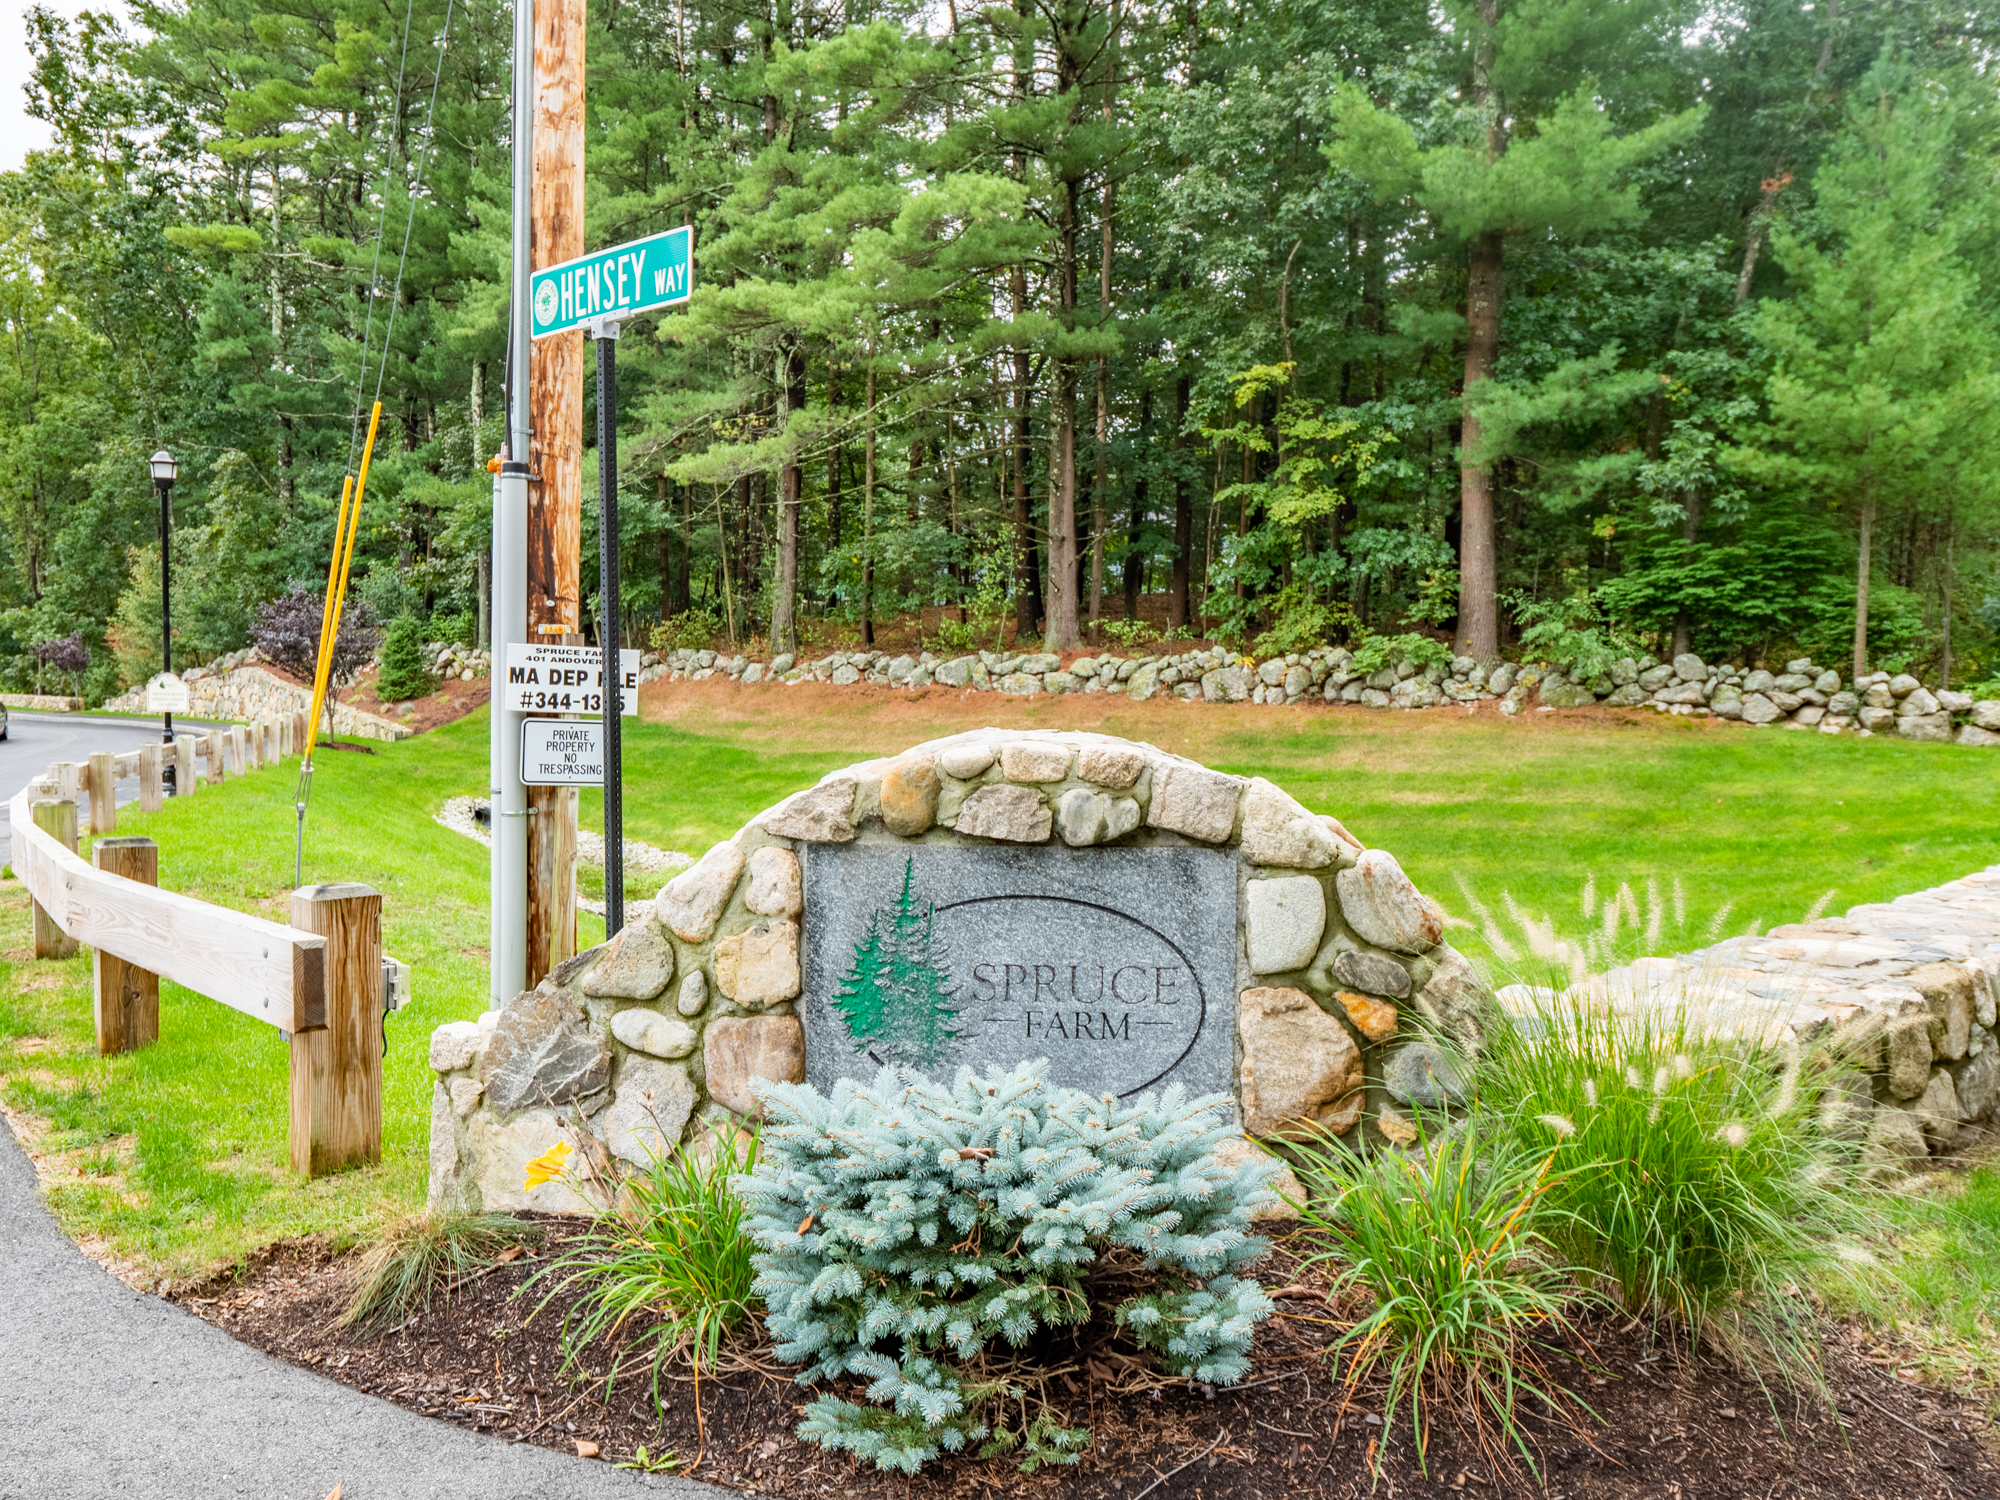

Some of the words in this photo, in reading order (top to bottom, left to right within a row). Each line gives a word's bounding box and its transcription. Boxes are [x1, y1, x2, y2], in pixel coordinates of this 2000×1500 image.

[561, 249, 646, 321] HENSEY
[654, 263, 686, 296] WAY
[535, 647, 581, 656] SPRUCE
[550, 656, 603, 665] ANDOVER
[509, 666, 540, 685] MA
[549, 668, 589, 687] DEP
[520, 691, 626, 712] #344-135
[552, 729, 590, 741] PRIVATE
[546, 740, 595, 752] PROPERTY
[564, 752, 577, 764] NO
[538, 763, 602, 776] TRESPASSING
[972, 963, 1181, 1005] SPRUCE
[1025, 1010, 1130, 1041] FARM
